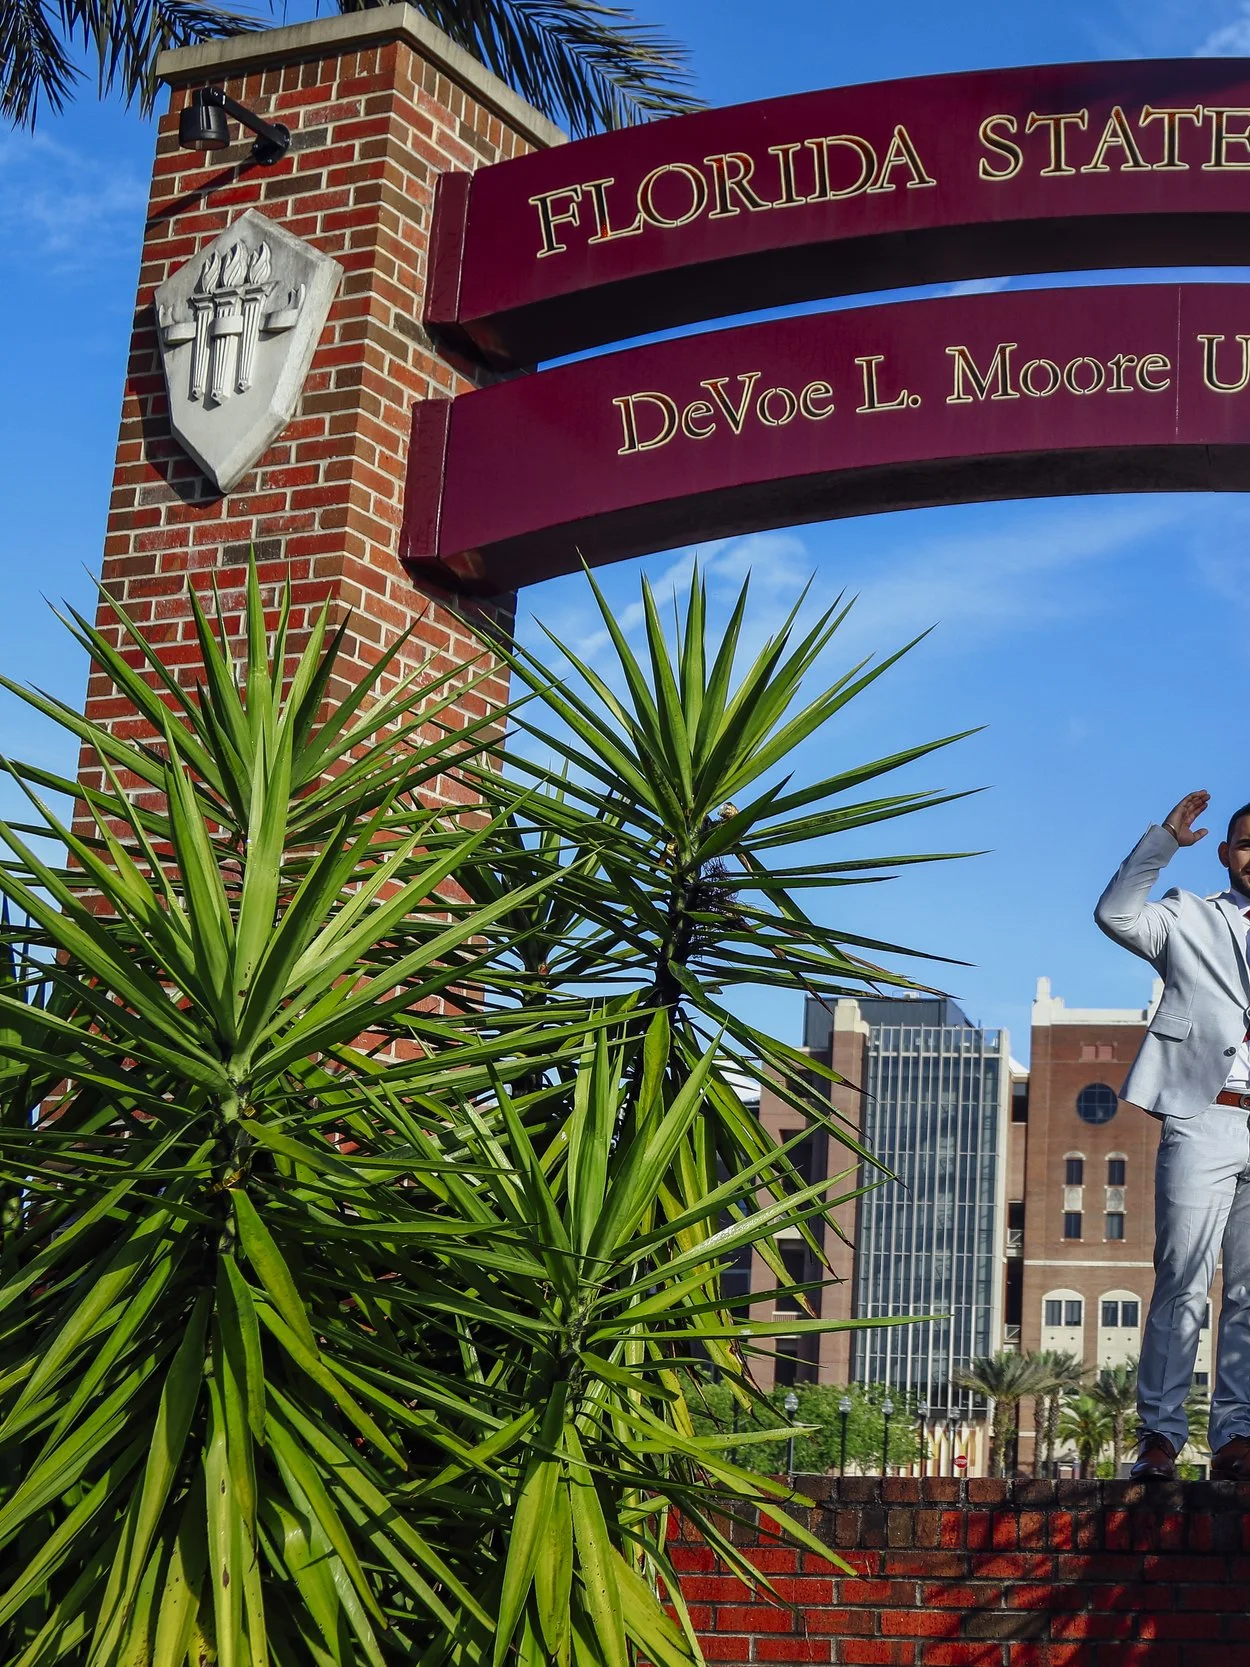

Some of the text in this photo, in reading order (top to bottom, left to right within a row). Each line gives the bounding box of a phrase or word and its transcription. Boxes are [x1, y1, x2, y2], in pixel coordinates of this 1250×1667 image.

[529, 124, 937, 259] FLORIDA
[612, 371, 836, 456] DeVoe
[855, 355, 921, 413] L.
[946, 342, 1173, 404] Moore
